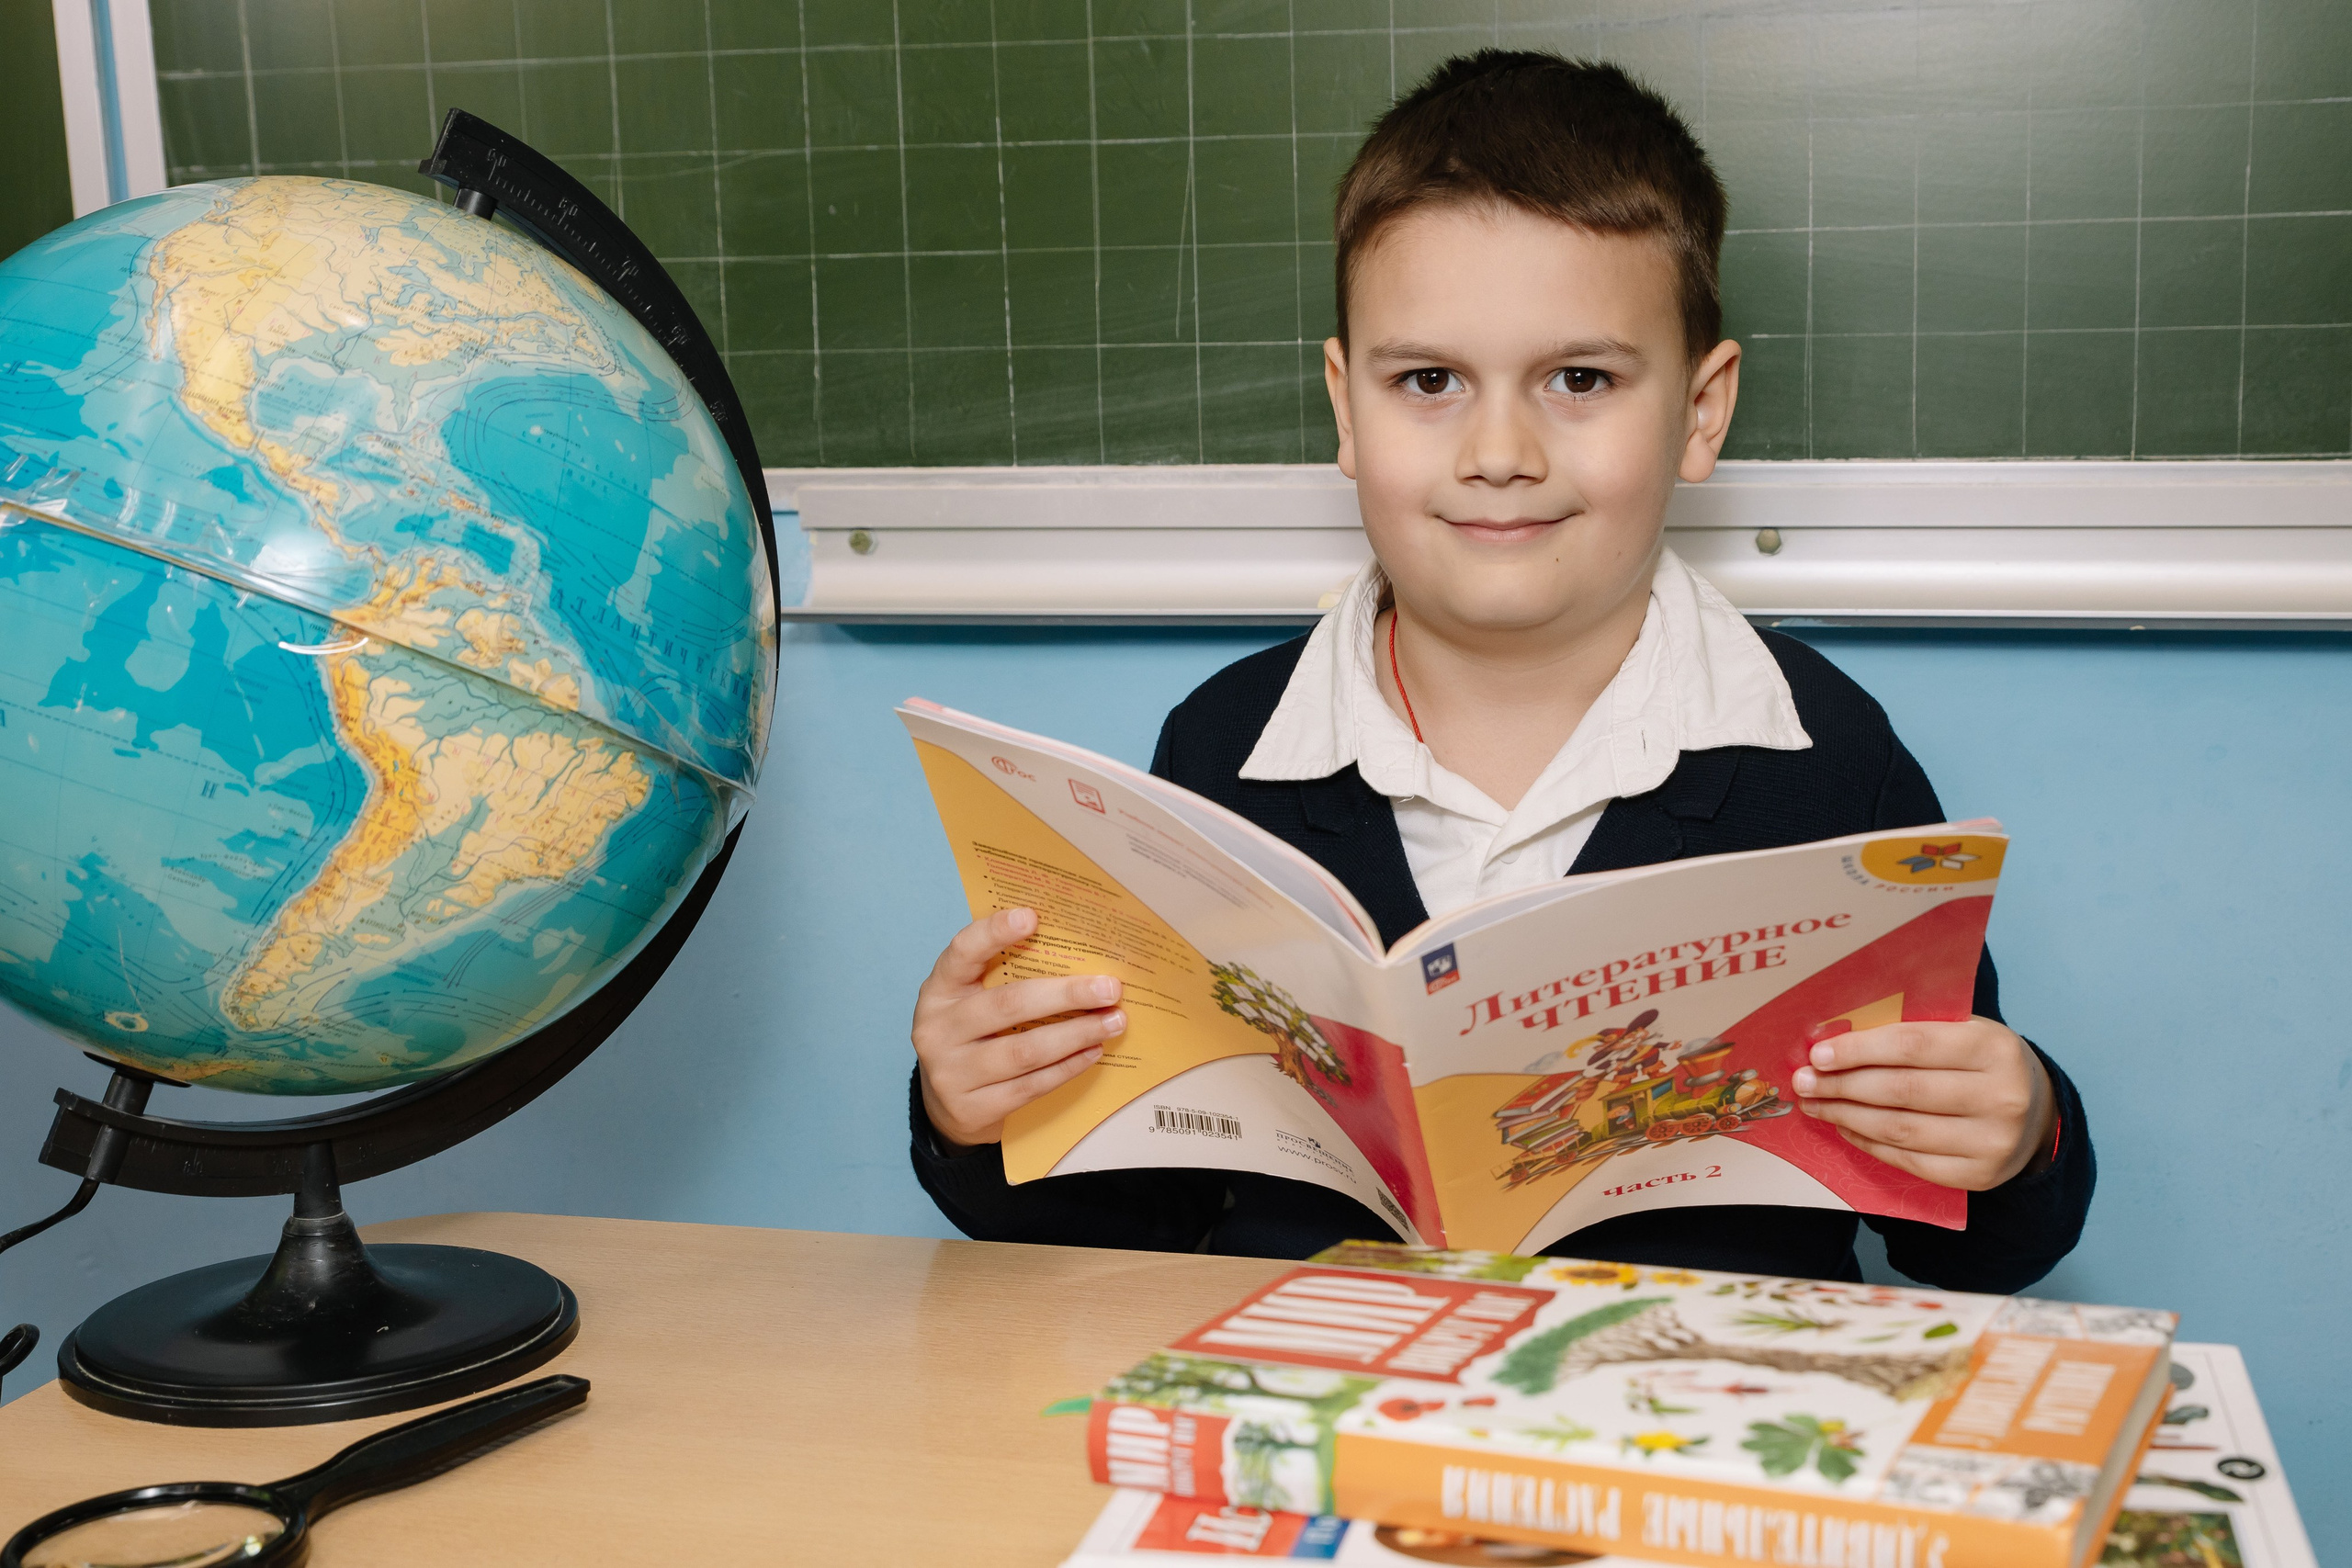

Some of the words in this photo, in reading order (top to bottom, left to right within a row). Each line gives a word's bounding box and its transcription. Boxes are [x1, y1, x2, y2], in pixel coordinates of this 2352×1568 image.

[1008, 952, 1039, 964] Рабочая
[1010, 962, 1047, 975] Тренажёр
[1459, 912, 1853, 1036] Литературное
[1517, 944, 1790, 1033] ЧТЕНИЕ
[1160, 1125, 1196, 1135] 785091
[1202, 1130, 1238, 1141] 023541
[1277, 1145, 1357, 1185] www.prosv.ru
[1601, 1170, 1698, 1200] часть
[1702, 1164, 1724, 1179] 2
[1442, 1464, 1622, 1540] РАСТЕНИЯ
